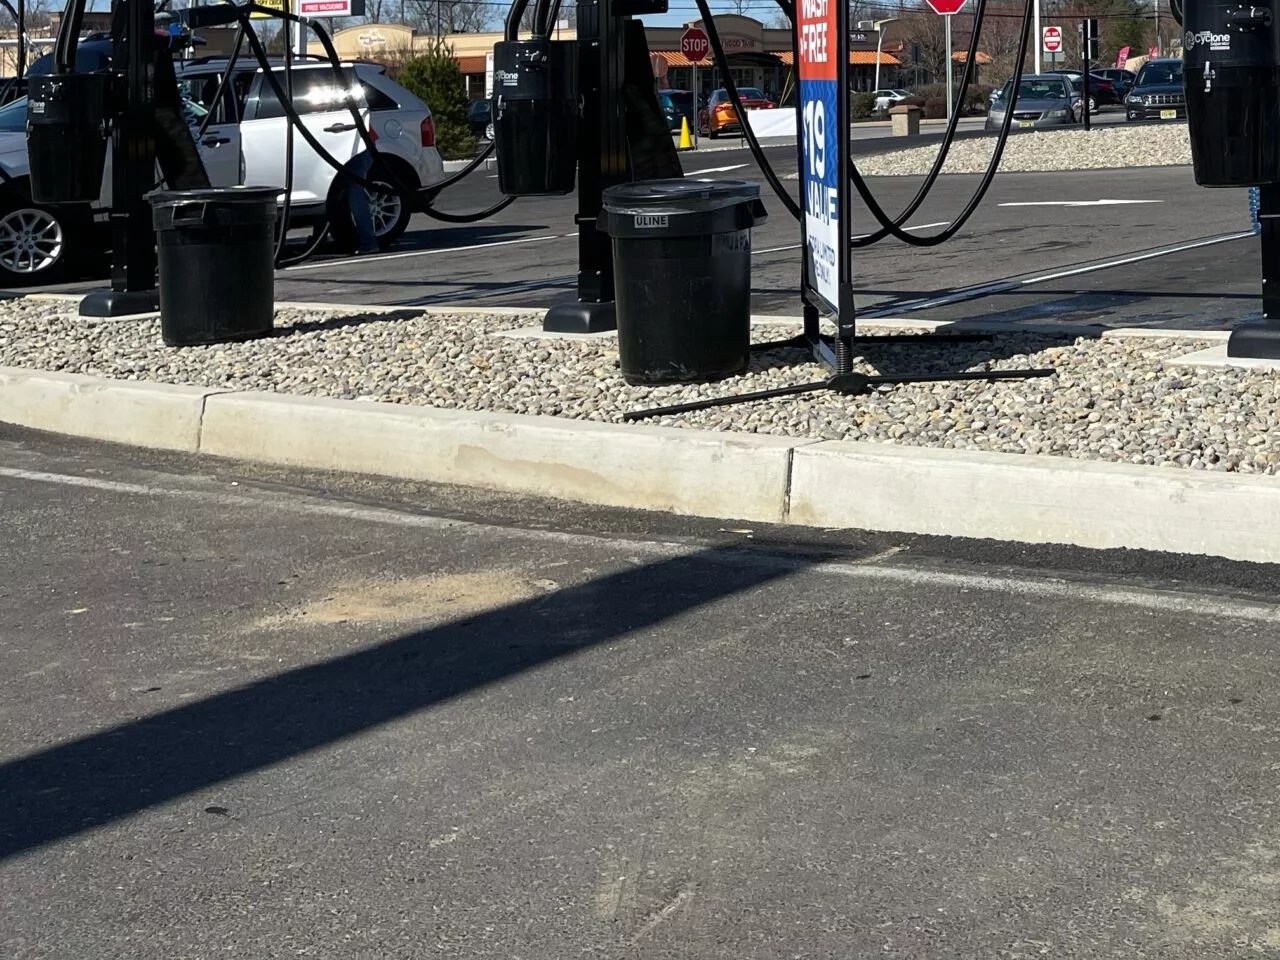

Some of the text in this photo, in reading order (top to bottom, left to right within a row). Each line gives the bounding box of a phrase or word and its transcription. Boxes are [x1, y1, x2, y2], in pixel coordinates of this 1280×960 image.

[683, 38, 708, 52] STOP
[1194, 32, 1231, 46] Cyclone
[636, 215, 668, 226] ULINE
